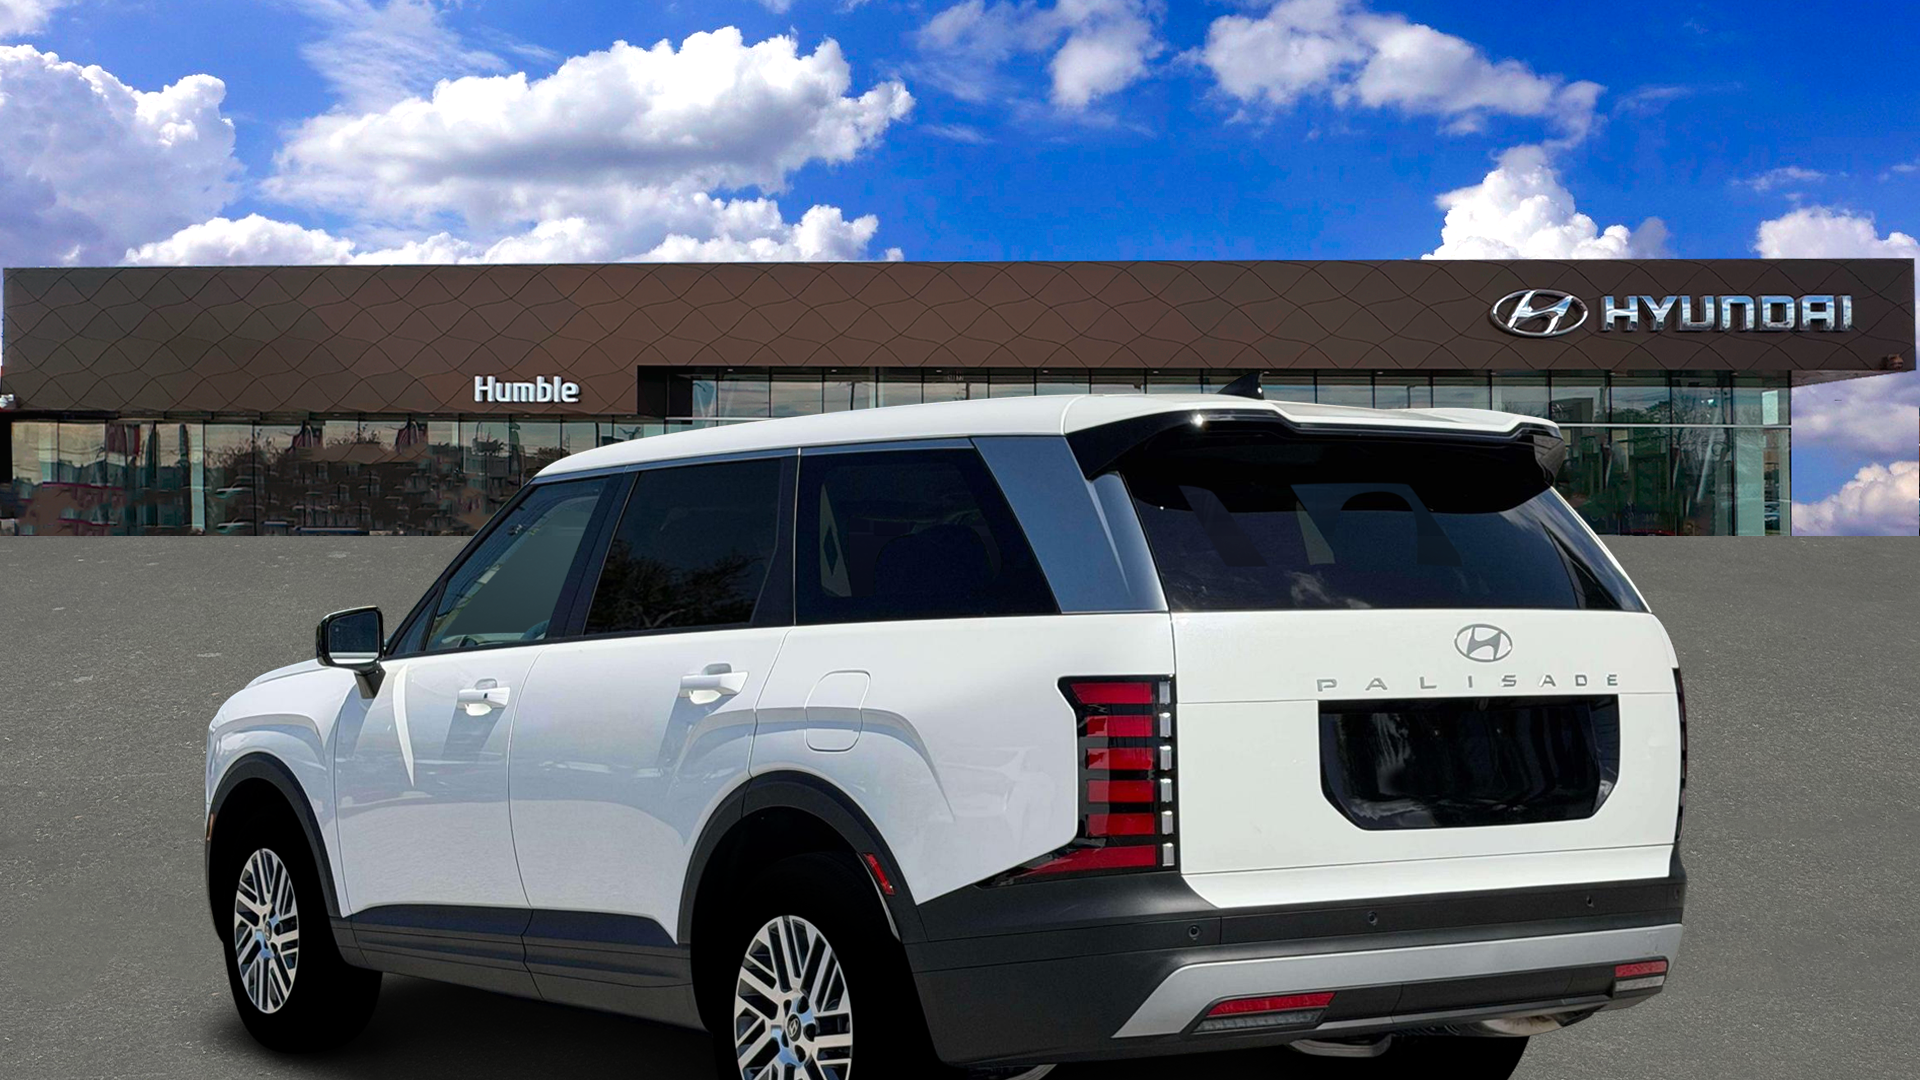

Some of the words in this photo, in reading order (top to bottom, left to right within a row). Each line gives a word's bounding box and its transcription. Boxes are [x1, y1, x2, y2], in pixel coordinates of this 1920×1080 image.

[1602, 295, 1854, 331] HYUNDAI
[474, 375, 580, 402] Humble
[1316, 673, 1619, 692] PALISADE
